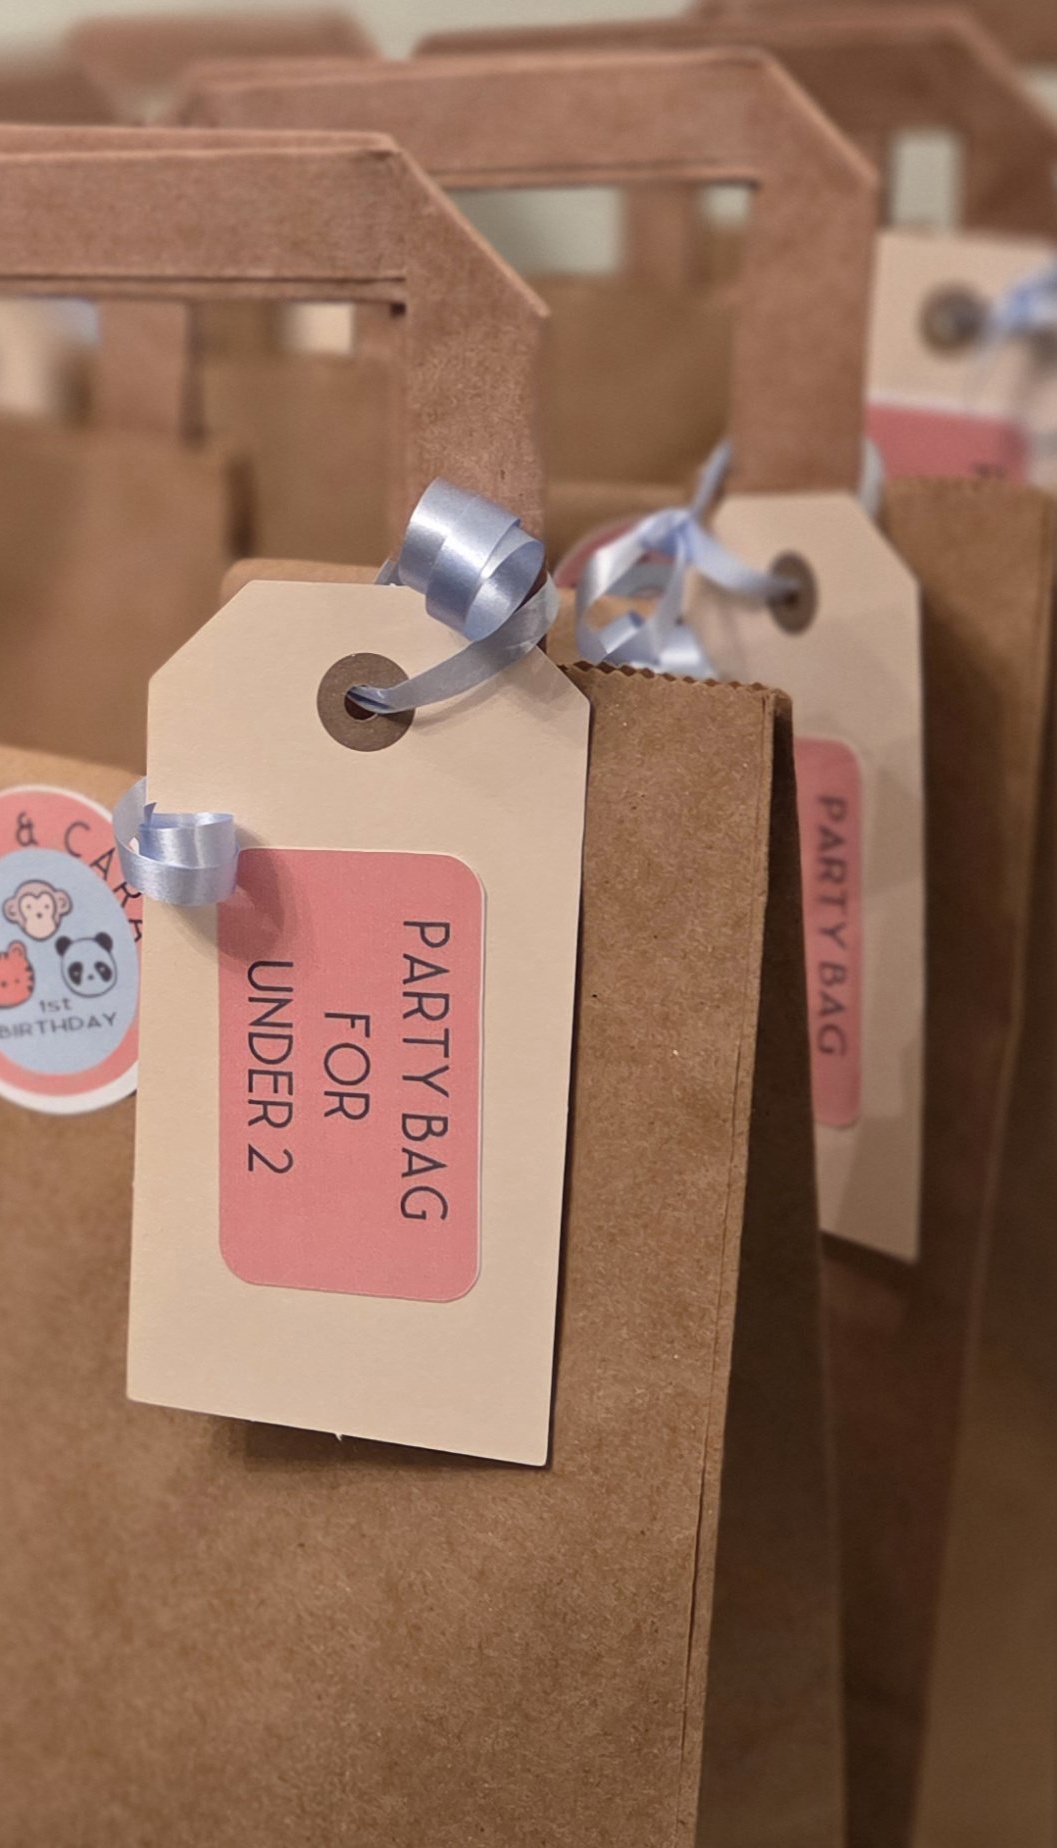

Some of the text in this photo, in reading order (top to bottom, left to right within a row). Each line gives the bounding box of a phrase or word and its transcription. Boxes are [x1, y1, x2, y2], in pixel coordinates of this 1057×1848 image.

[15, 811, 39, 848] &
[38, 997, 73, 1013] 1st
[816, 794, 849, 1057] PARTY BAG
[246, 960, 295, 1175] UNDER 2
[322, 1011, 372, 1121] FOR
[399, 920, 451, 1221] PARTY BAG
